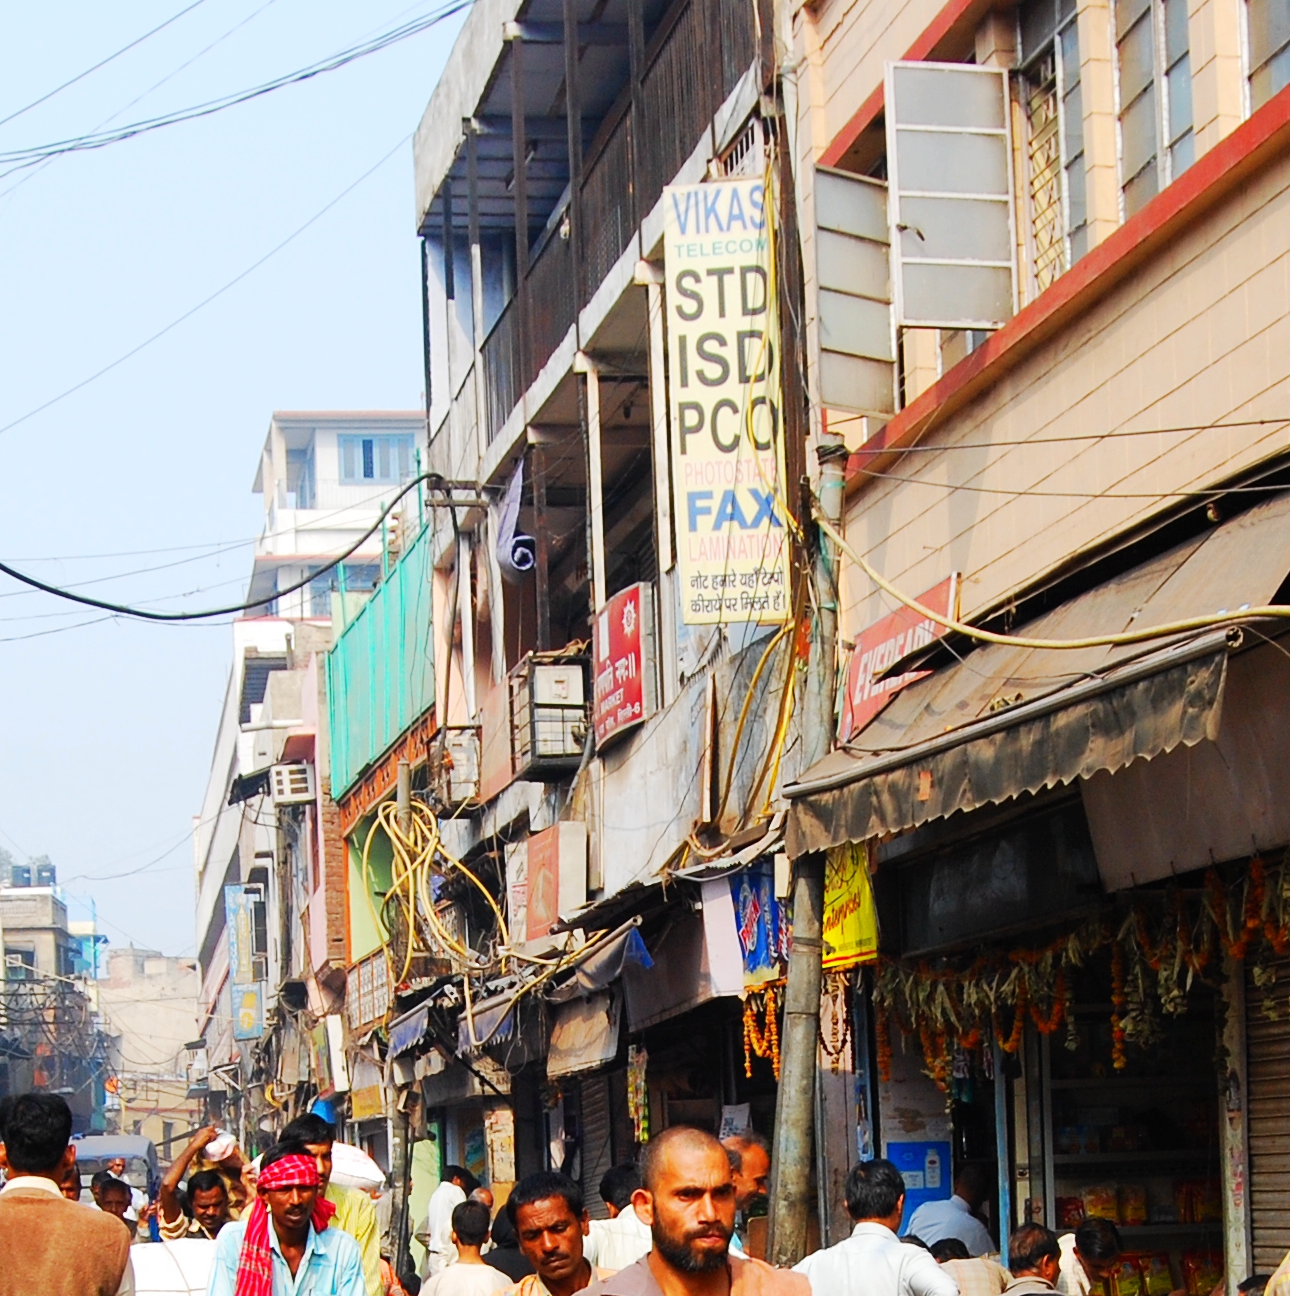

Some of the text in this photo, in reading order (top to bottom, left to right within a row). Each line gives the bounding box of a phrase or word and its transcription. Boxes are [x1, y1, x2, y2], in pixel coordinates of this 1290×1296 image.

[671, 182, 766, 236] VIKAS
[675, 265, 770, 322] STD
[678, 329, 774, 389] ISD
[678, 395, 780, 456] PCO
[687, 488, 783, 533] FAX
[689, 533, 784, 562] LAMINATION
[690, 570, 709, 590] नोट
